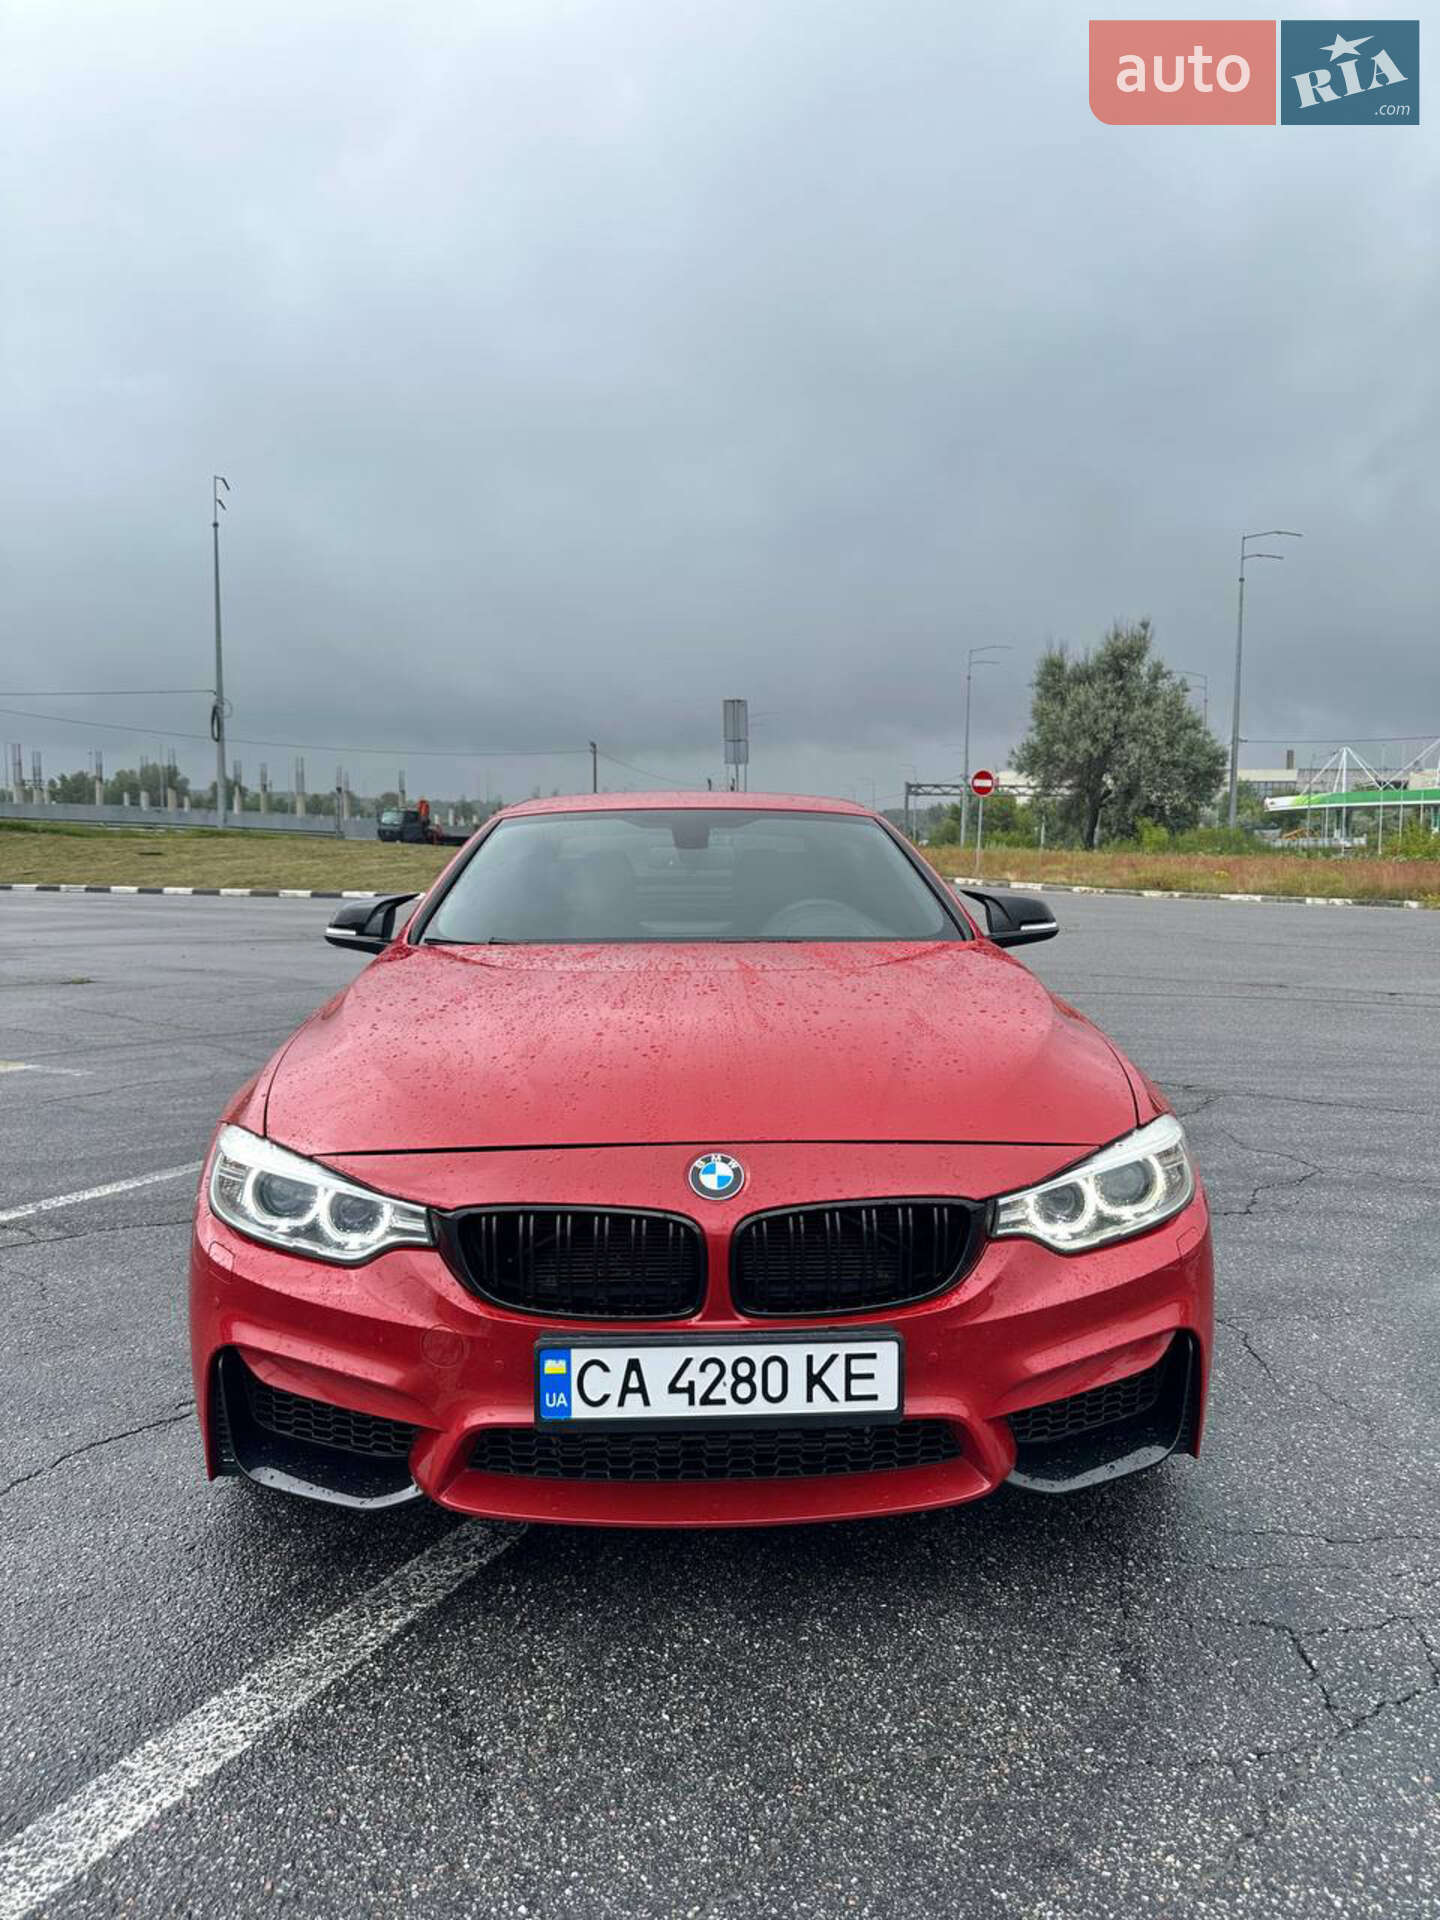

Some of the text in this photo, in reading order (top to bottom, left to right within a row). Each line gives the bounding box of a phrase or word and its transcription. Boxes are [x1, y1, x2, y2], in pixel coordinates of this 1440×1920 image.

[576, 1352, 878, 1407] CA 4280 KE
[545, 1392, 568, 1408] UA
